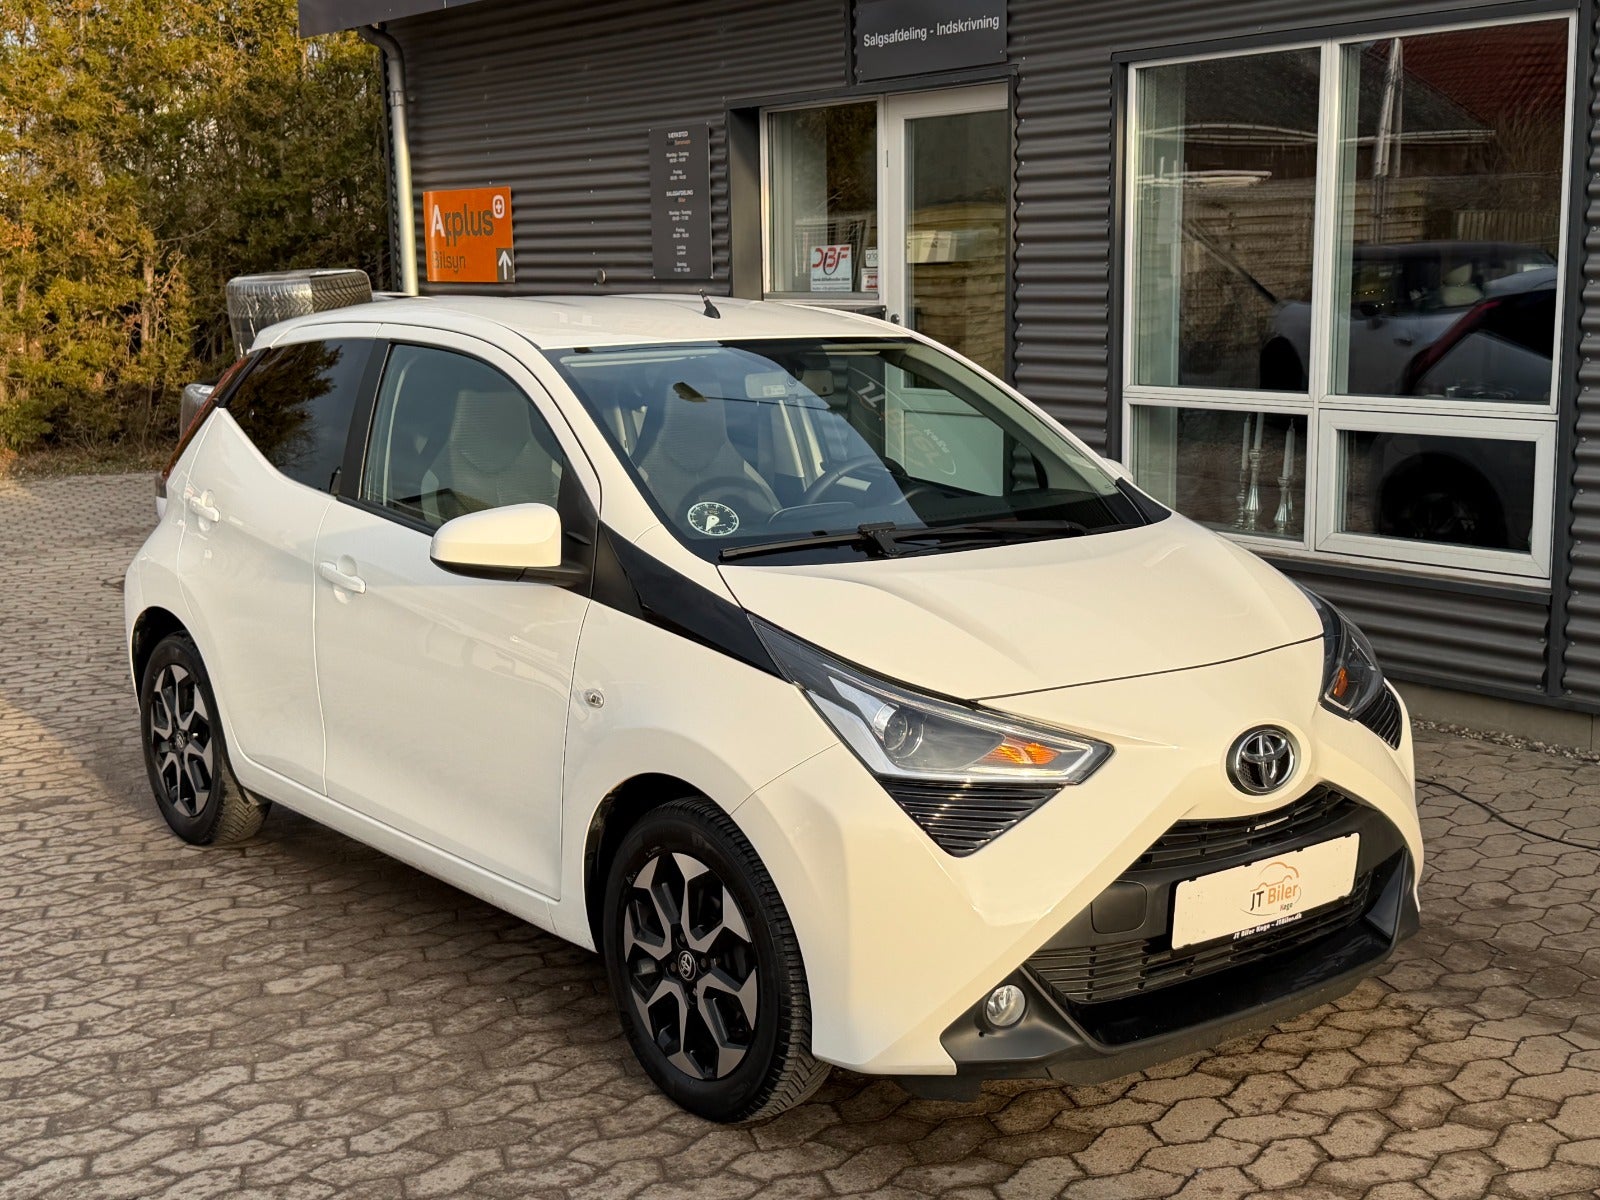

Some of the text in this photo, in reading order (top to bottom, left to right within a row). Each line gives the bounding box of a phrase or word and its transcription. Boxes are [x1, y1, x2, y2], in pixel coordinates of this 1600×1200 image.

[863, 27, 927, 47] Salgsafdeling
[936, 15, 1000, 36] Indskrivning
[432, 251, 466, 274] Bilsyn
[1250, 883, 1298, 911] JT Biler
